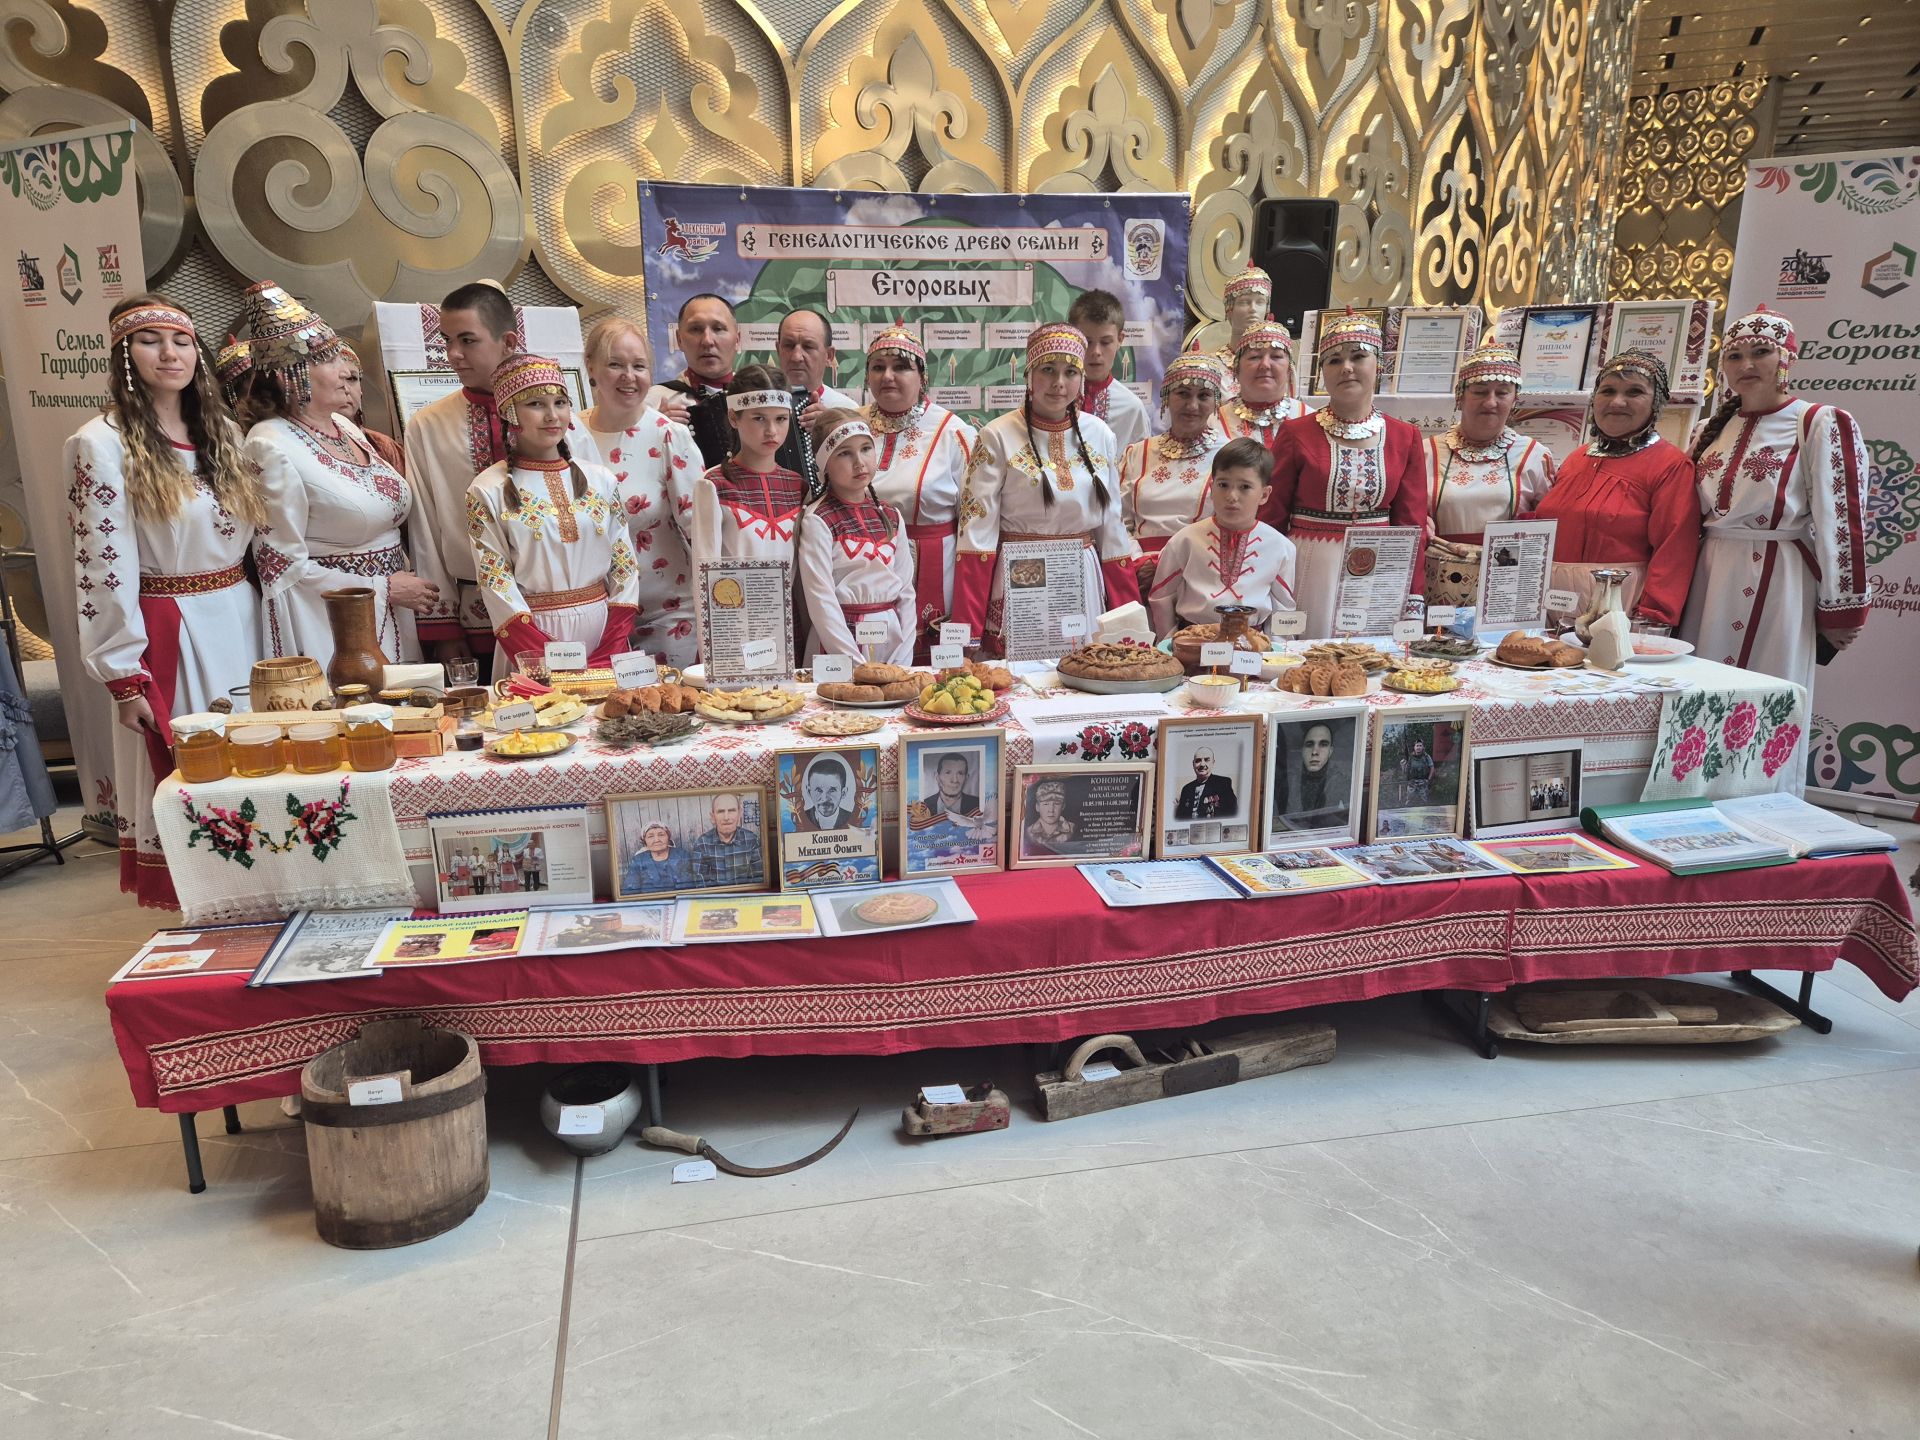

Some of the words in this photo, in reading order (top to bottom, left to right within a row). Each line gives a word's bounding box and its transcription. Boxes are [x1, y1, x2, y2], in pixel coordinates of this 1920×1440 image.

[681, 224, 726, 236] АЛЕКСЕЕВСКИЙ
[768, 232, 949, 250] ГЕНЕАЛОГИЧЕСКОЕ
[954, 236, 1010, 252] ДРЕВО
[1017, 235, 1079, 250] СЕМЬИ
[1781, 260, 1798, 272] 20
[101, 271, 122, 283] 2026
[1779, 272, 1796, 282] 26
[872, 272, 991, 303] Егоровых
[56, 328, 106, 351] Семья
[1090, 776, 1129, 784] КОНОНОВ
[456, 828, 497, 836] Чувашский
[499, 824, 550, 832] национальный
[812, 834, 848, 844] Кононов
[798, 846, 831, 857] Михаил
[834, 844, 862, 854] Фомич
[456, 916, 526, 926] НАЦИОНАЛЬНАЯ
